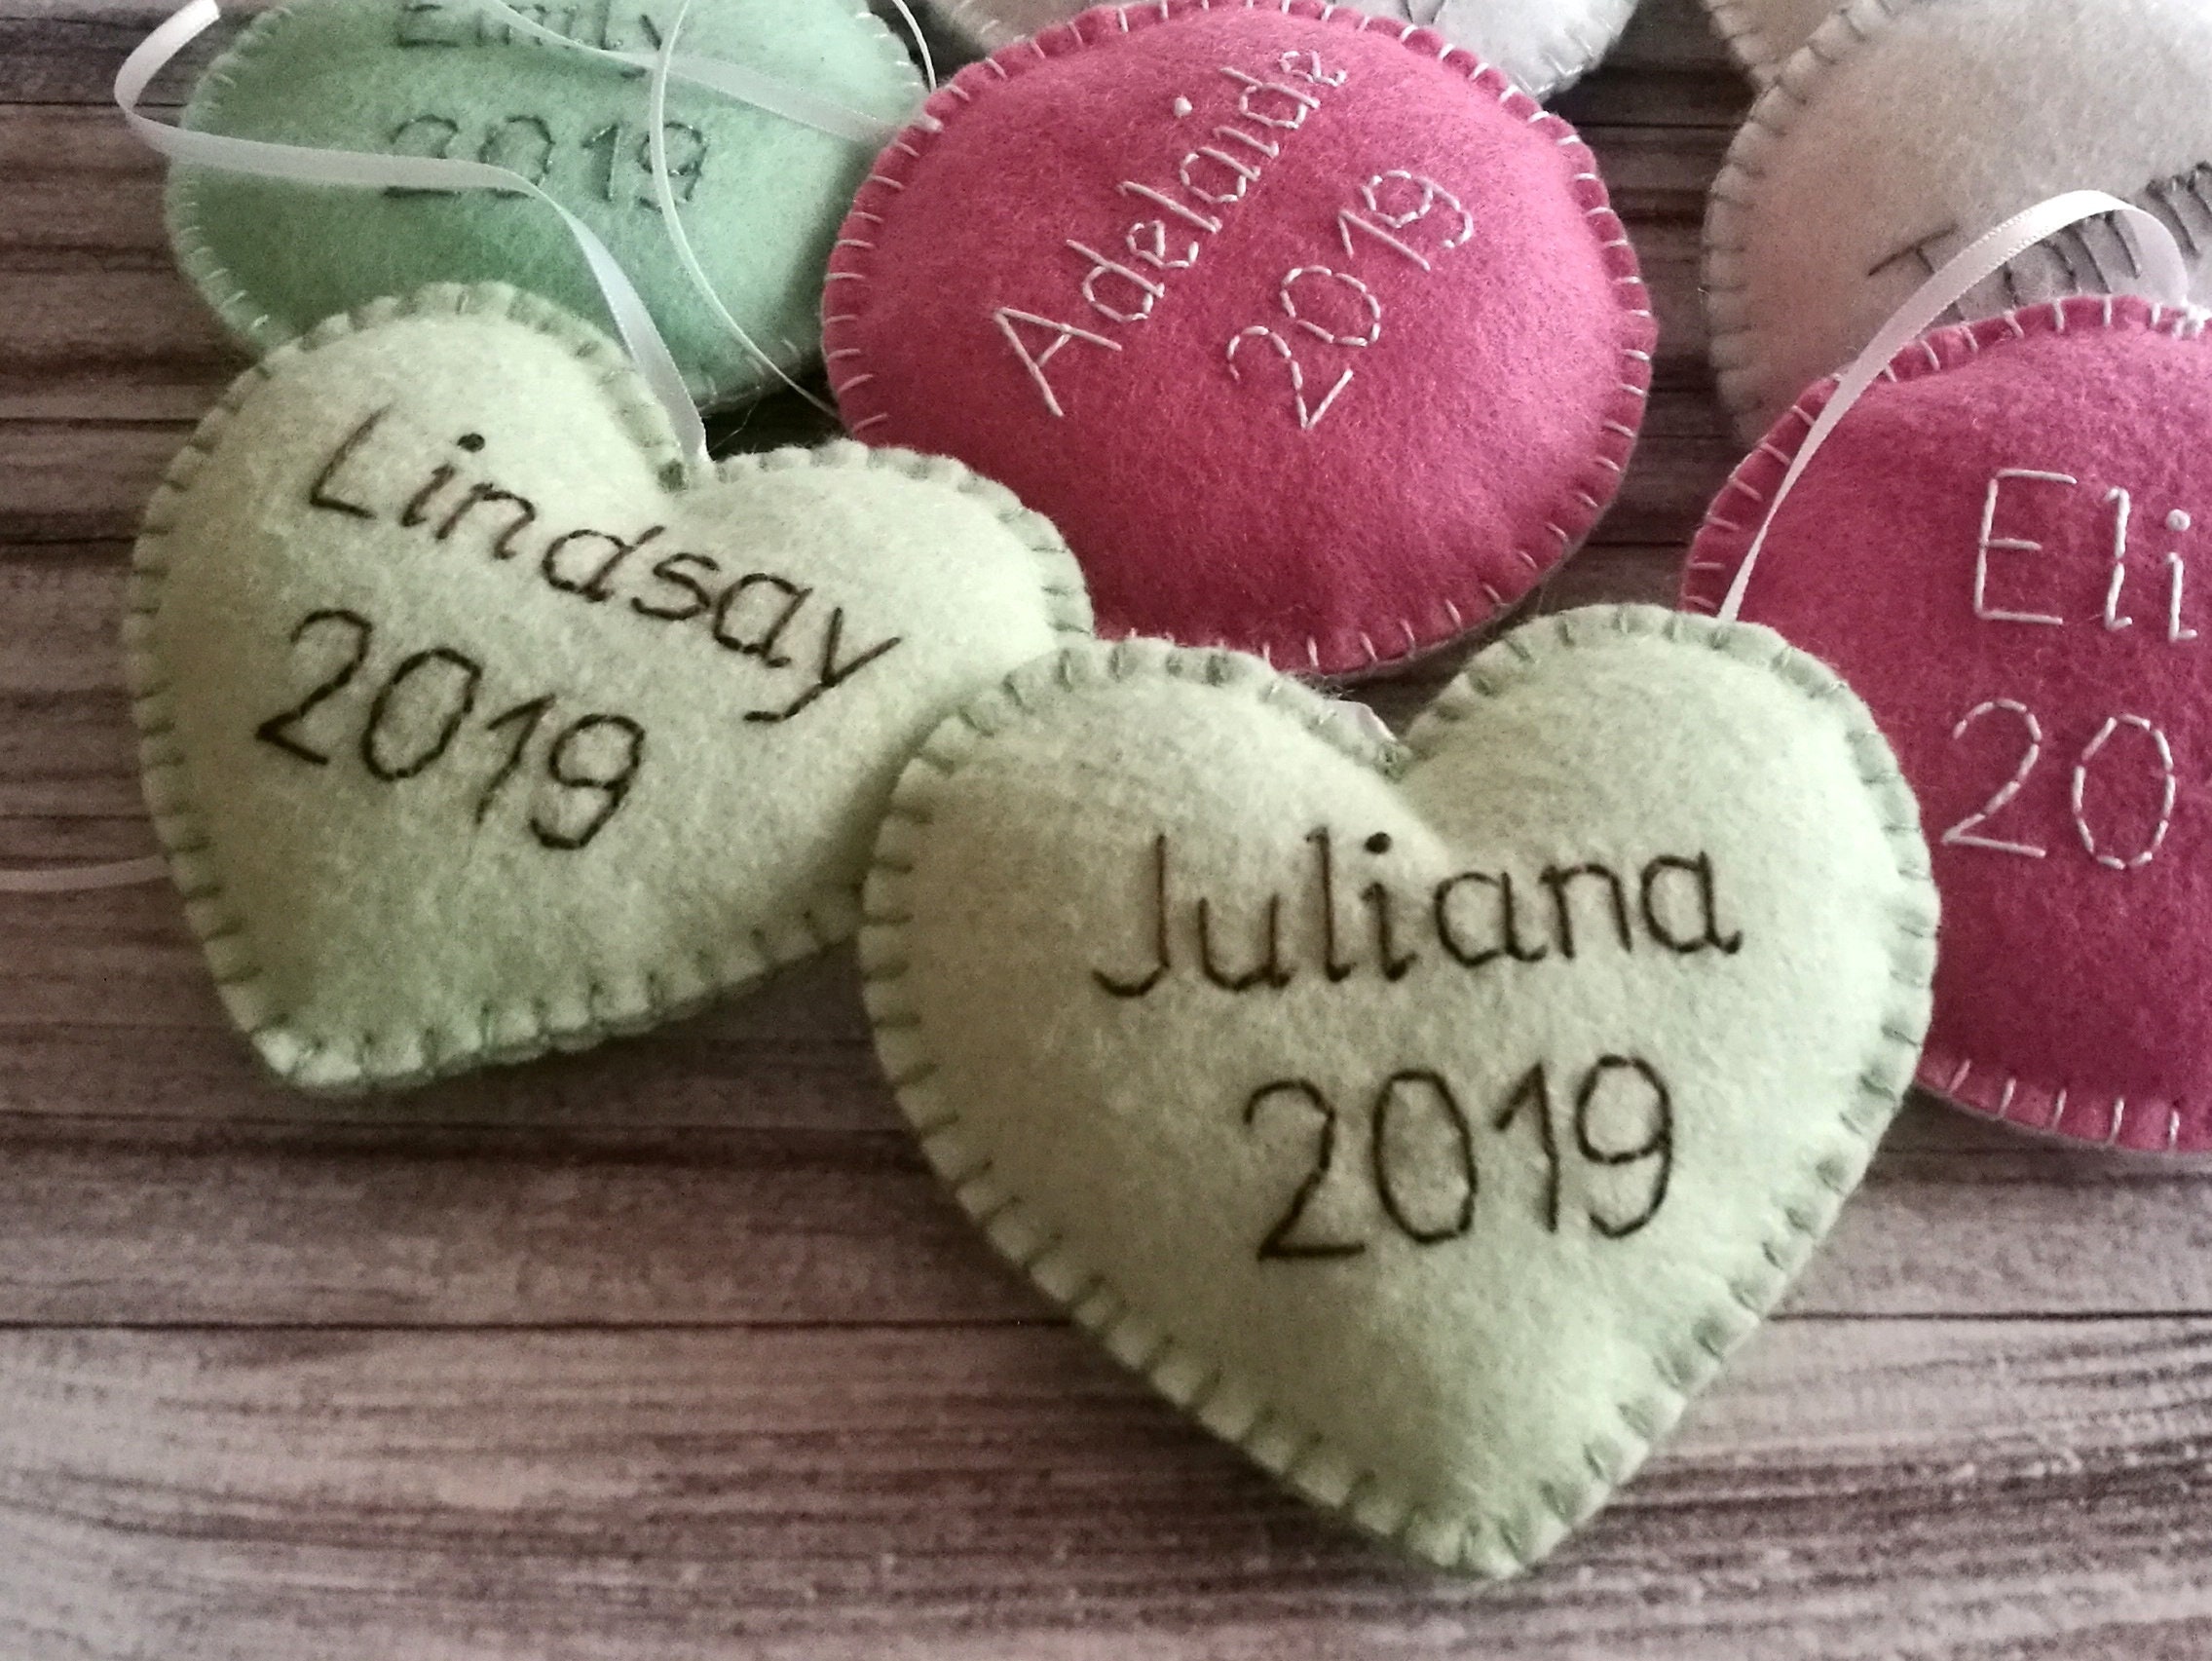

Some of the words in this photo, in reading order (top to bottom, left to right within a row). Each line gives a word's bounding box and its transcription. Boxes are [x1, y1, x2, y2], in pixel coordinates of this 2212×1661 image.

[386, 114, 709, 216] 2019
[992, 49, 1348, 419] Adelaide
[1224, 169, 1474, 431] 2019
[308, 403, 902, 723] Lindsay
[1971, 468, 2198, 643] Eli
[254, 608, 647, 849] 2019
[1940, 698, 2177, 870] 20
[1091, 824, 1743, 998] Juliana
[1242, 1054, 1673, 1262] 2019
